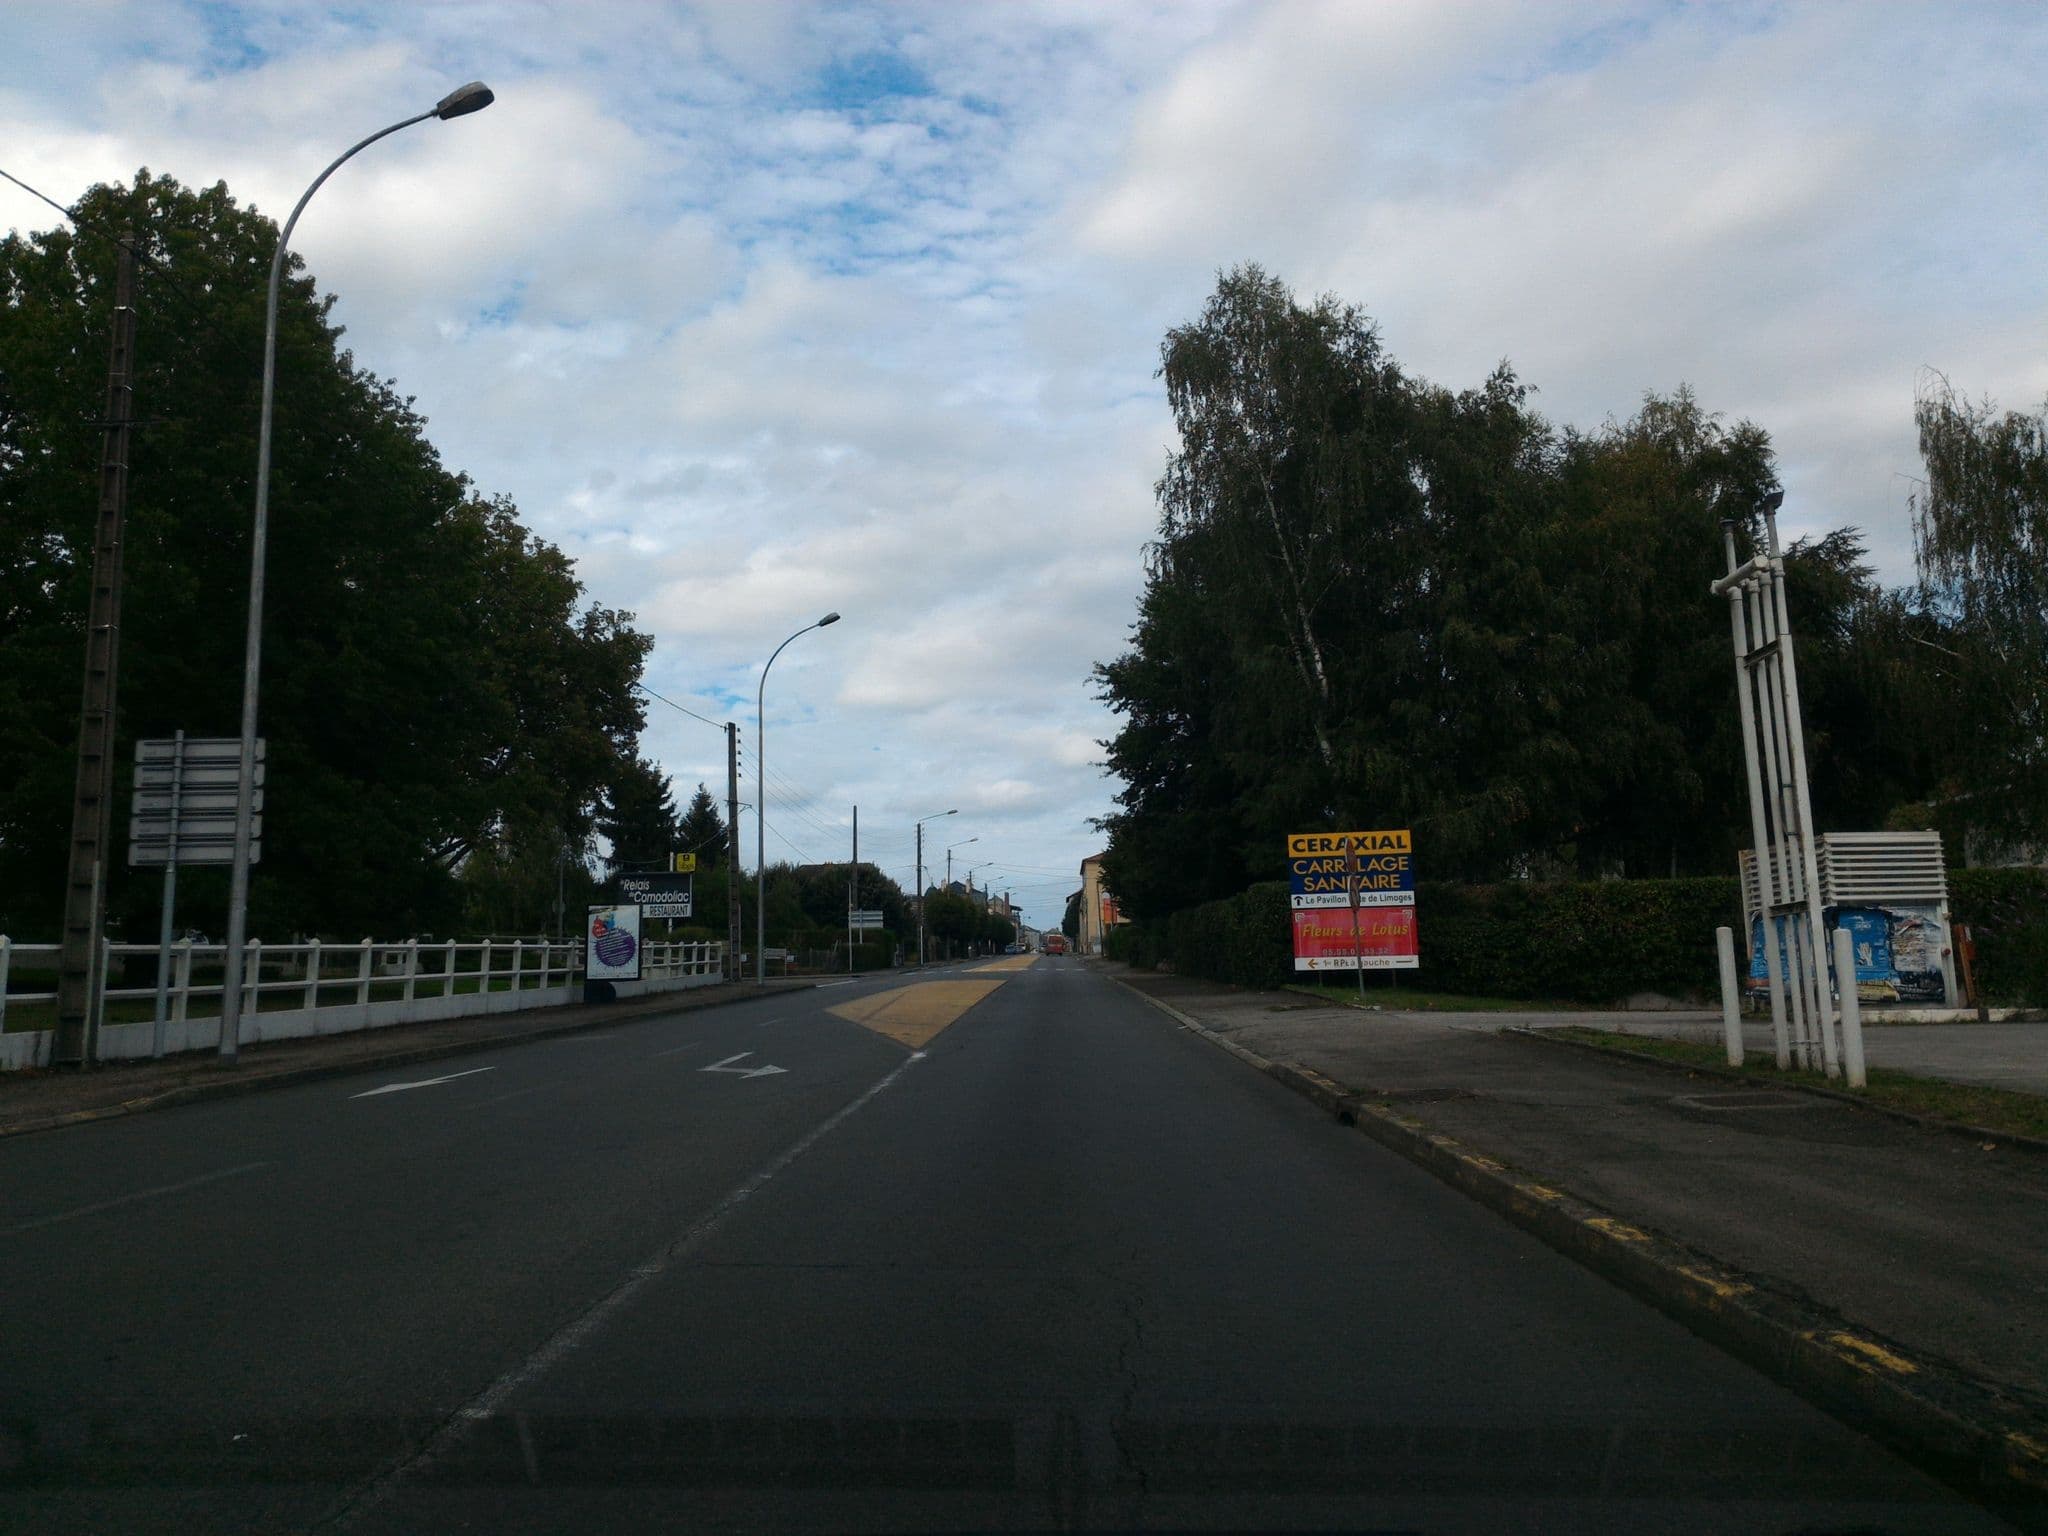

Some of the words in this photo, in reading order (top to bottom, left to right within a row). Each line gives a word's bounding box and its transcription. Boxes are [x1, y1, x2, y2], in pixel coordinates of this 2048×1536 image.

[1292, 836, 1408, 852] CERAXIAL
[1293, 856, 1409, 874] CARRLAGE
[624, 879, 650, 890] Relais
[1304, 874, 1400, 892] SANAIRE
[1316, 895, 1347, 904] Pavillon
[1368, 894, 1378, 902] de
[1380, 892, 1412, 903] Limoges
[649, 905, 688, 916] RESTAURANT
[1303, 922, 1343, 937] Fleurs
[1372, 920, 1409, 936] Lotus
